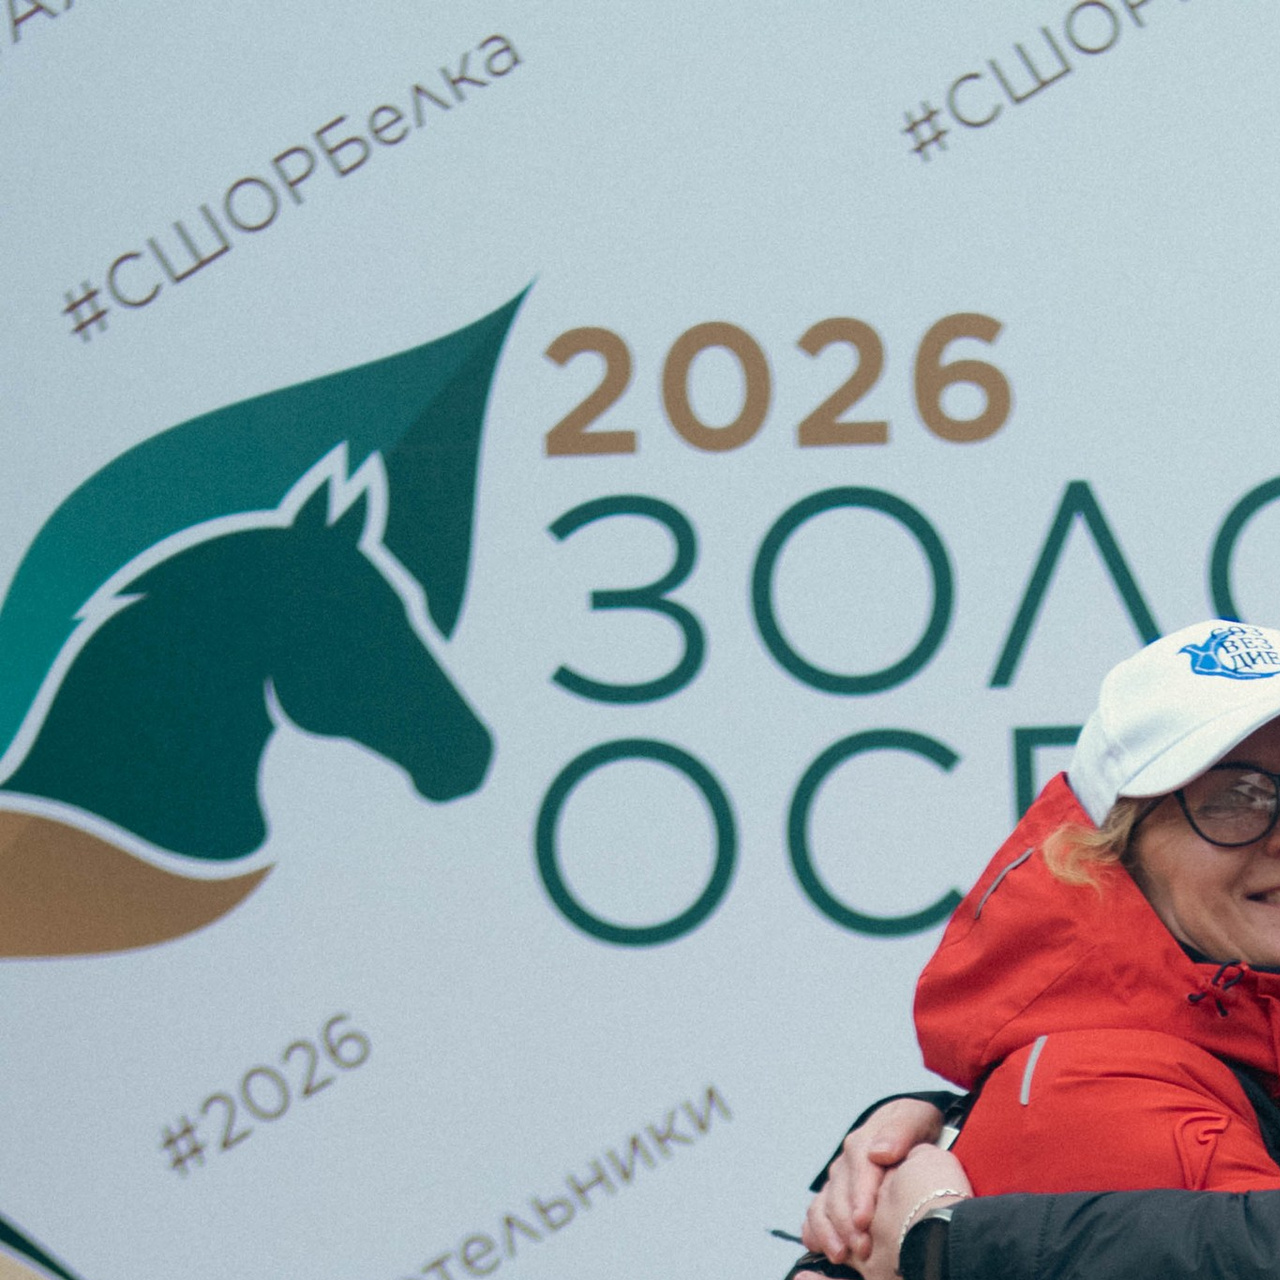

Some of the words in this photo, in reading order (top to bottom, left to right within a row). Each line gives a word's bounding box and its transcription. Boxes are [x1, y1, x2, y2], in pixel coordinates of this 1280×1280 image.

[62, 33, 525, 343] #СШОРБелка
[545, 313, 1013, 458] 2026
[1221, 637, 1274, 654] ВЕЗ
[160, 1012, 373, 1176] #2026
